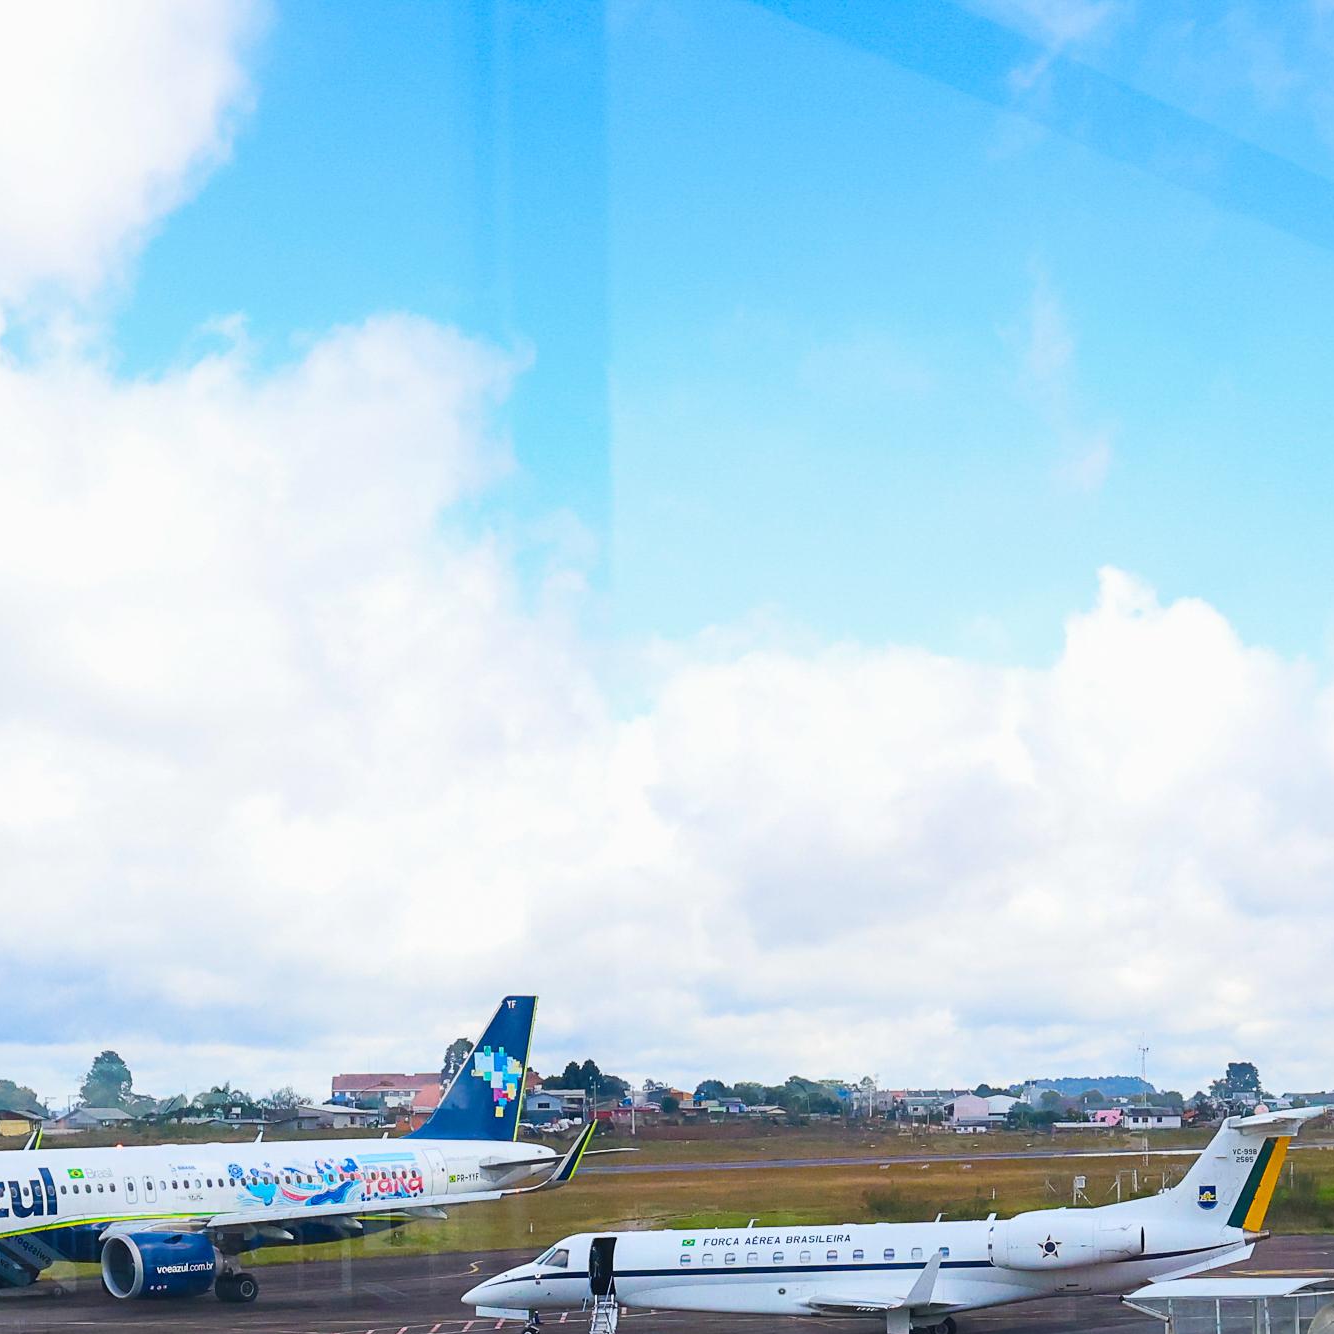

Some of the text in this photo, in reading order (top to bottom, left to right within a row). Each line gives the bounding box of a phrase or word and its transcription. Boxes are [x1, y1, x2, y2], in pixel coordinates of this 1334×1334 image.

[506, 1000, 517, 1009] YF
[84, 1167, 114, 1179] Brasil
[703, 1234, 851, 1247] FORÇA AÉREA BRASILEIRA
[156, 1262, 214, 1274] voeazul.com.br
